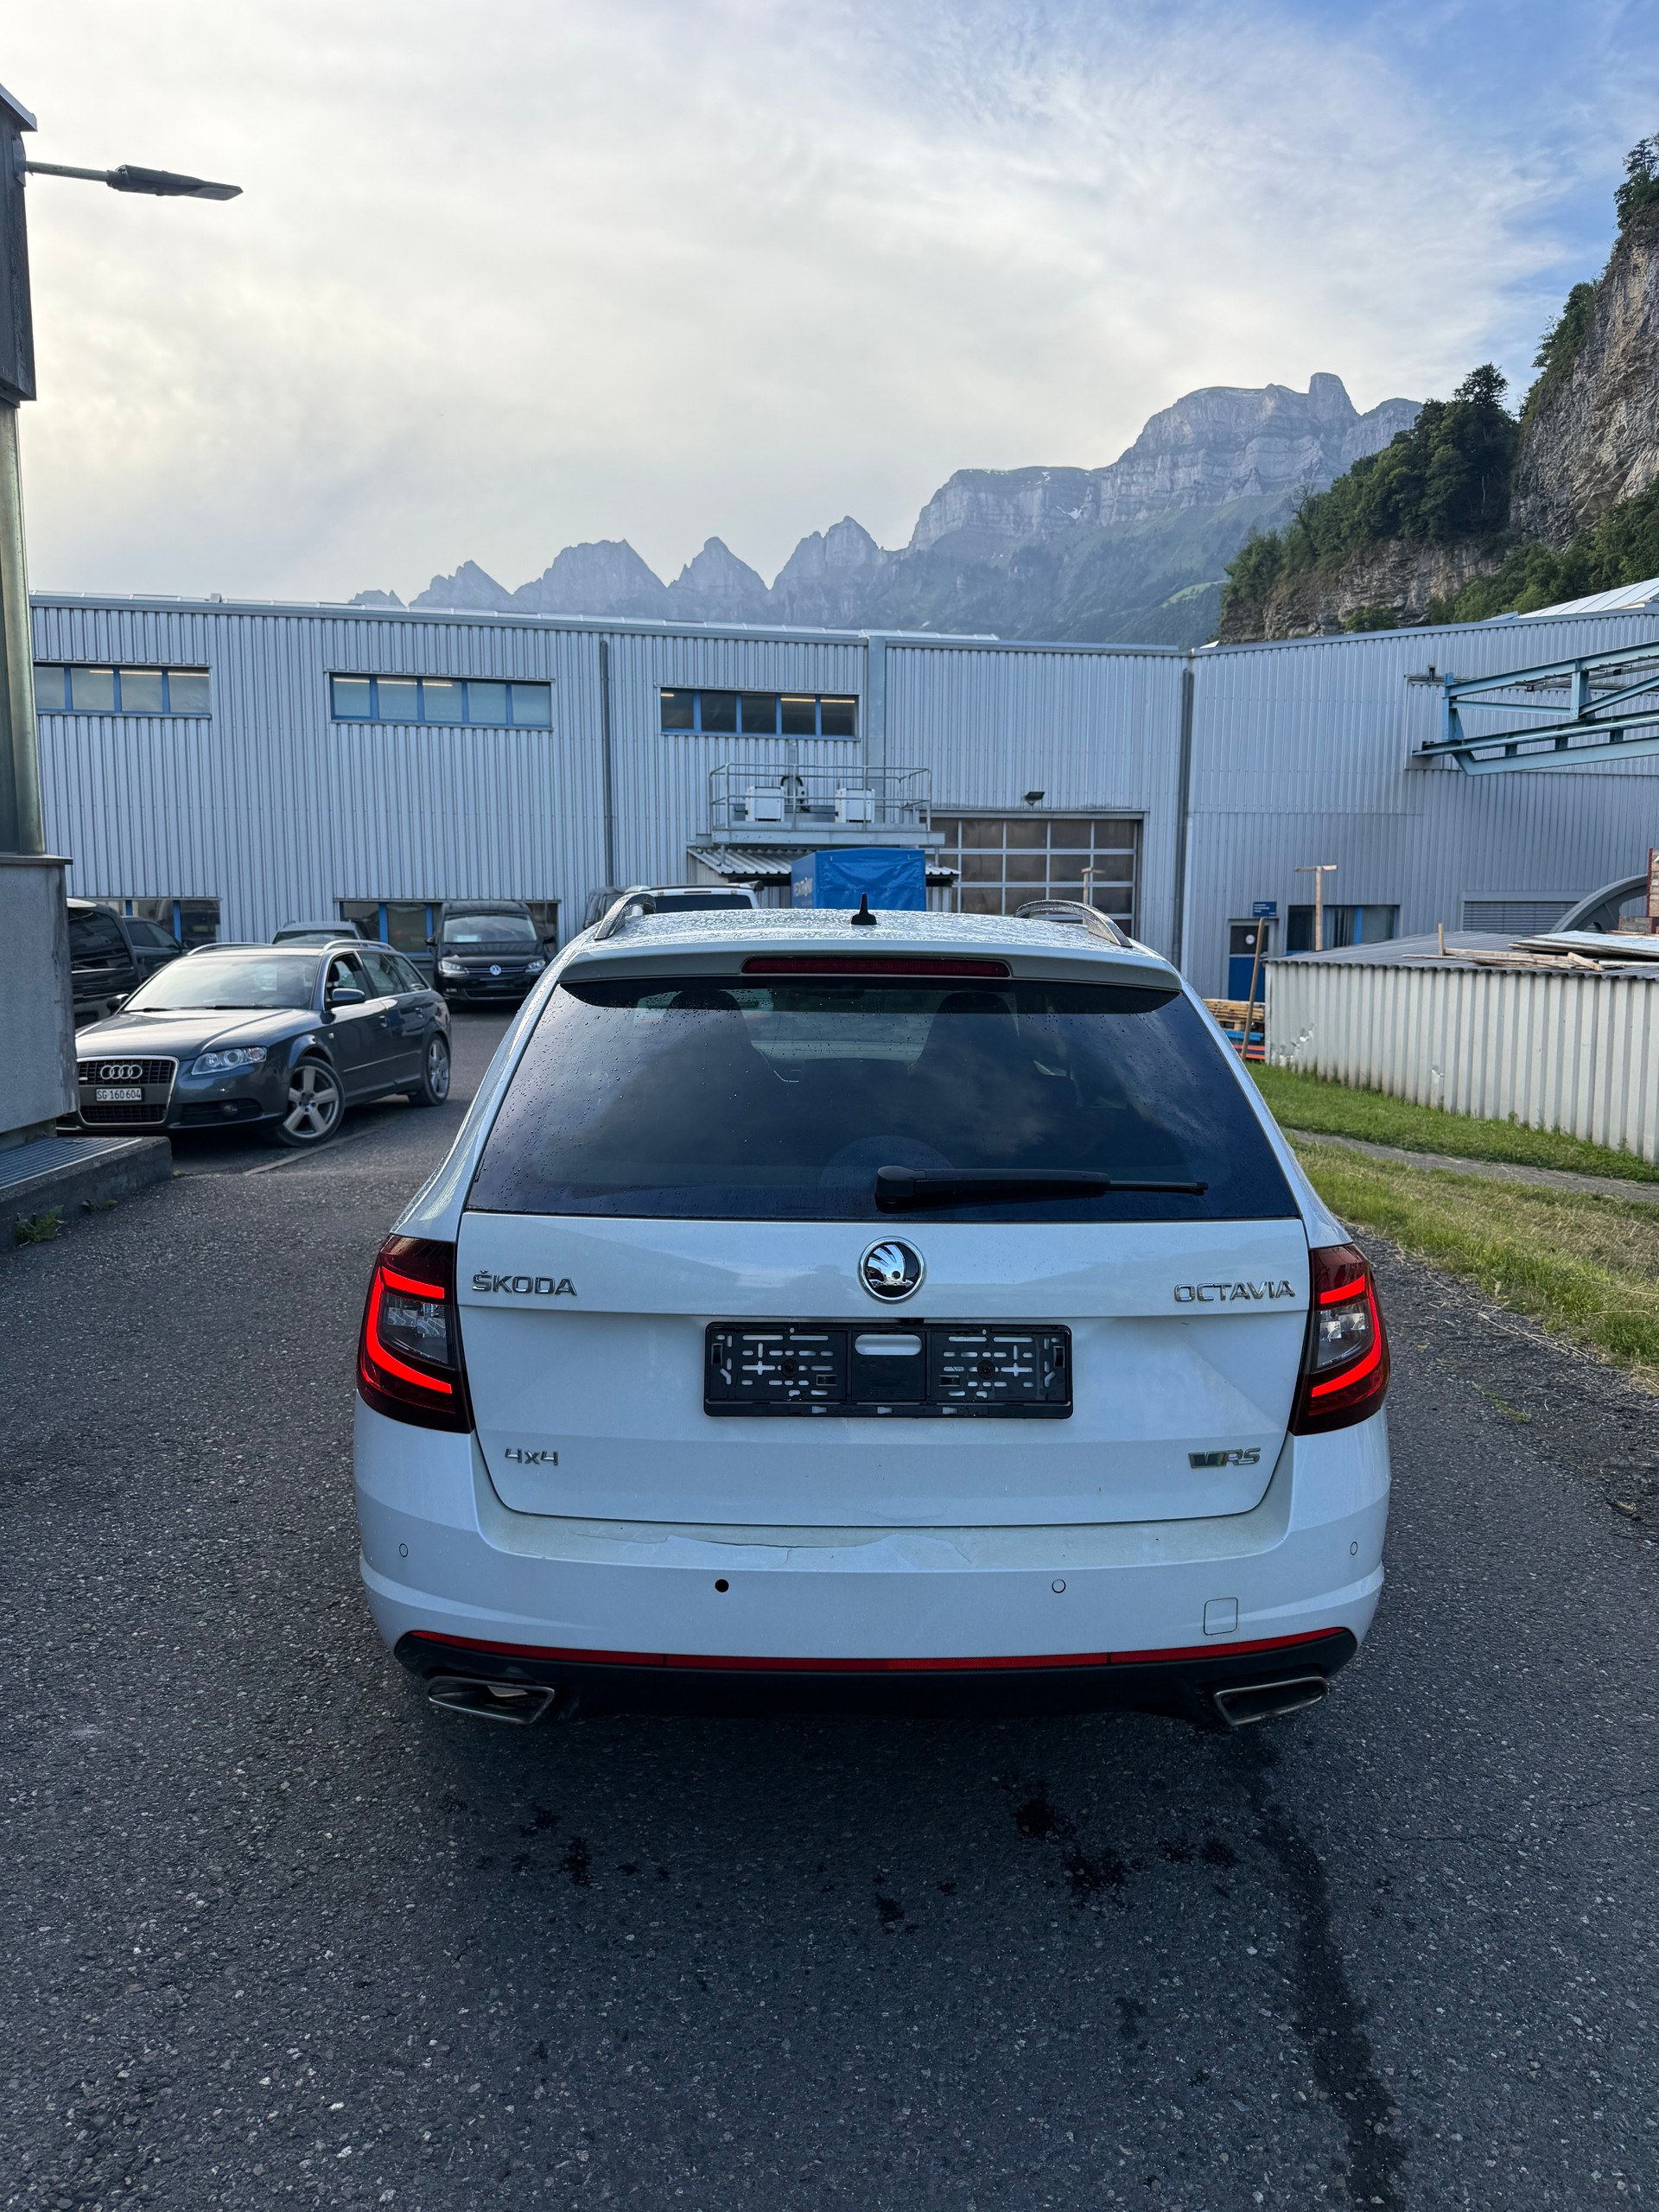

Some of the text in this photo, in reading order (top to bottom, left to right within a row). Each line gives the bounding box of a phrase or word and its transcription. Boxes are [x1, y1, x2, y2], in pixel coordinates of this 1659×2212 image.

[472, 1270, 577, 1296] ŠKODA
[1174, 1281, 1295, 1302] OCTAVIA
[505, 1448, 559, 1466] 4x4
